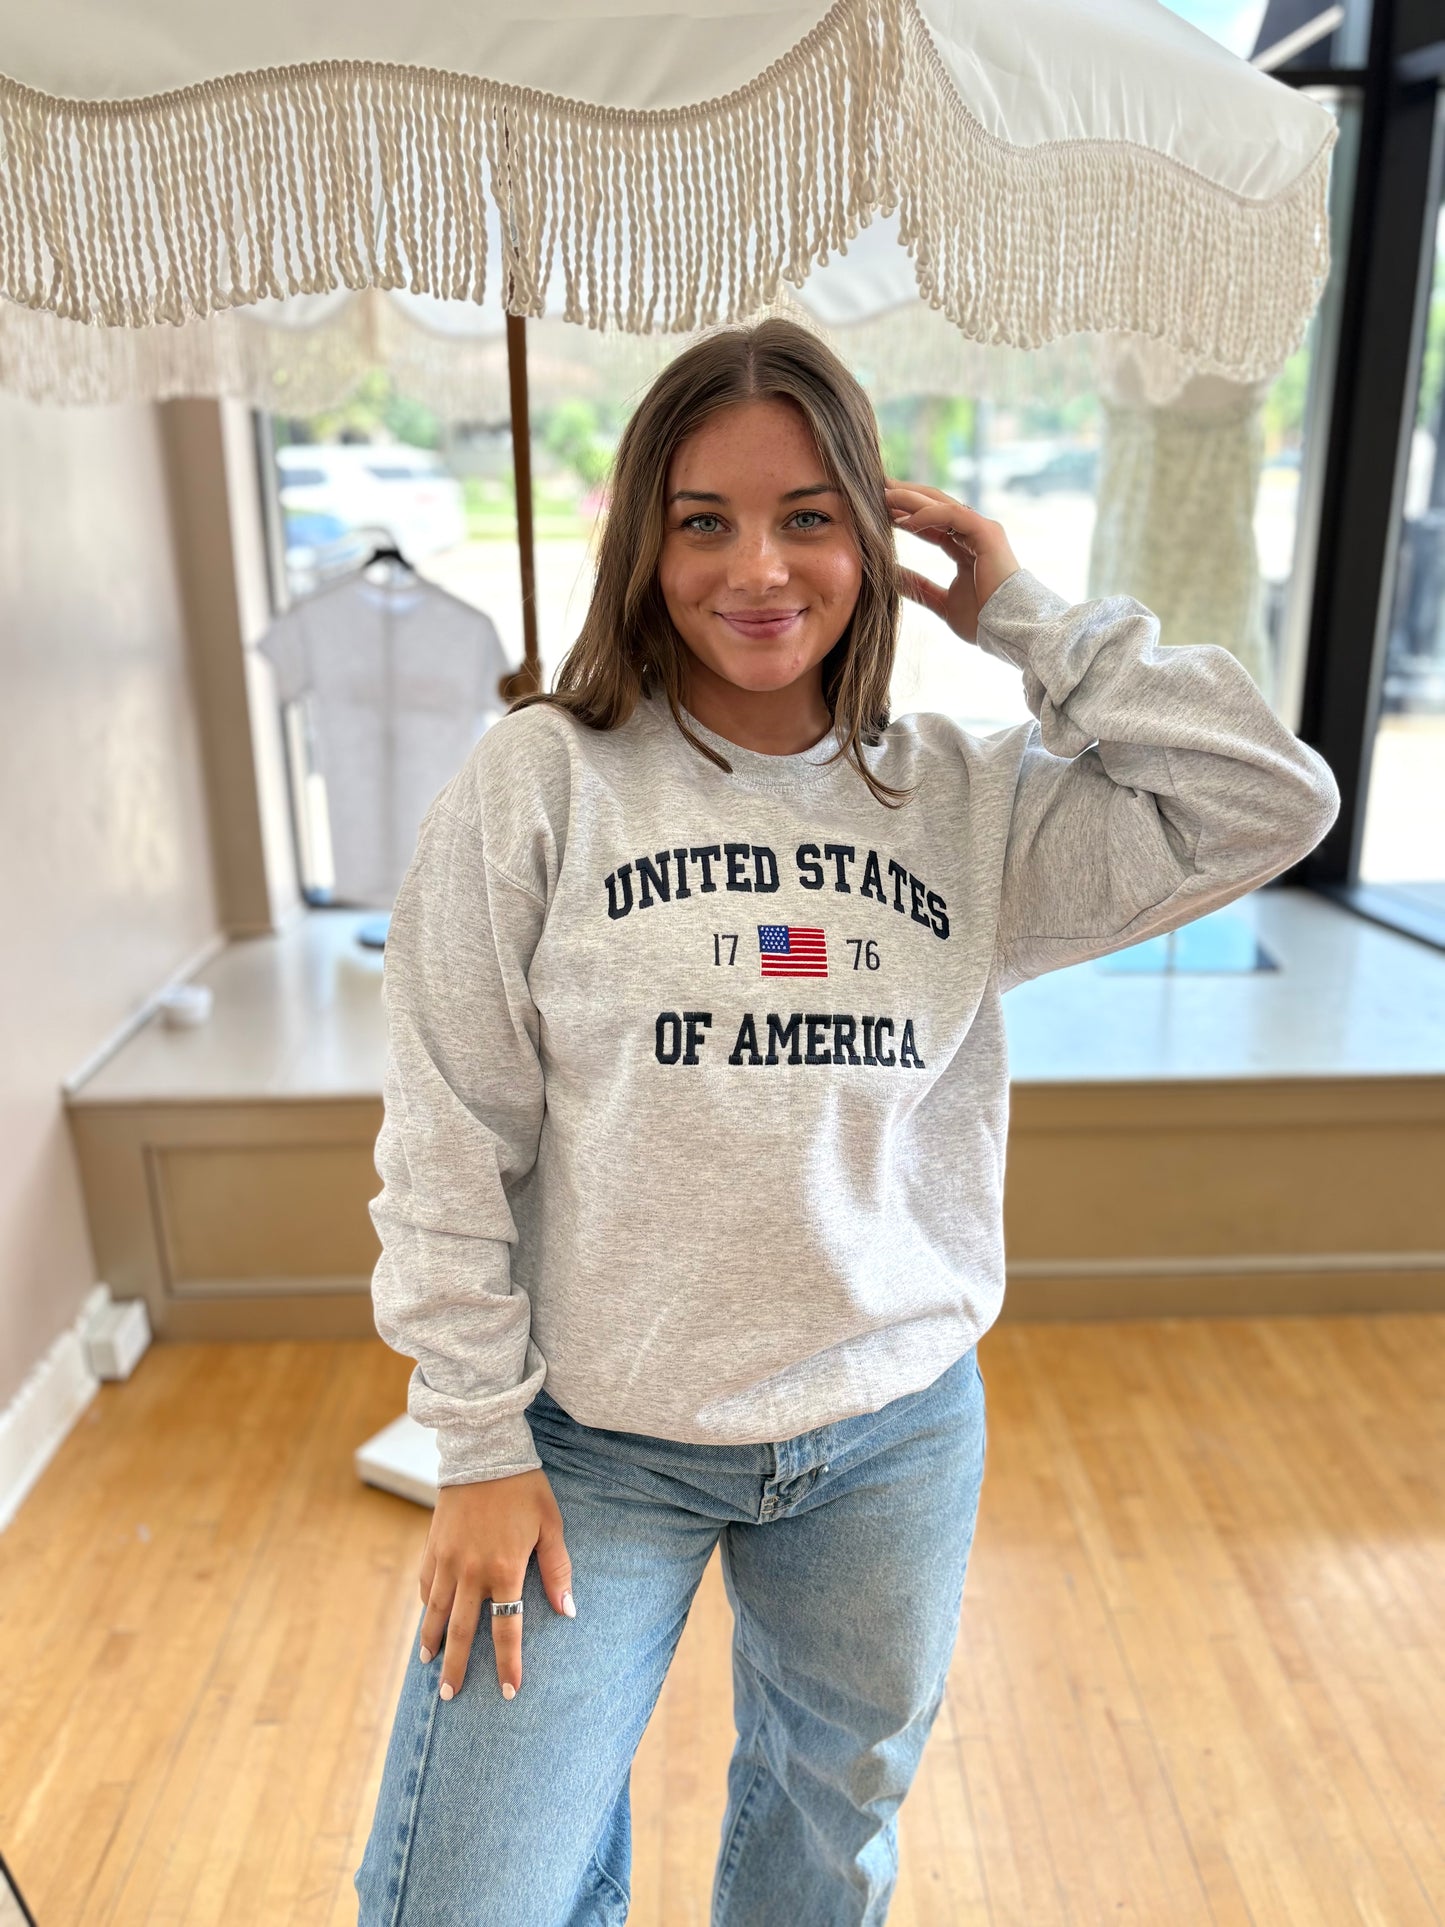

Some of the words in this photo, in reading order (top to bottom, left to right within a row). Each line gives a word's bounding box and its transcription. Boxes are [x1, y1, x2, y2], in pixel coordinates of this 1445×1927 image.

[604, 842, 781, 921] UNITED
[795, 842, 952, 941] STATES
[713, 933, 739, 968] 17
[846, 938, 882, 972] 76
[654, 1011, 713, 1066] OF
[728, 1012, 926, 1069] AMERICA
